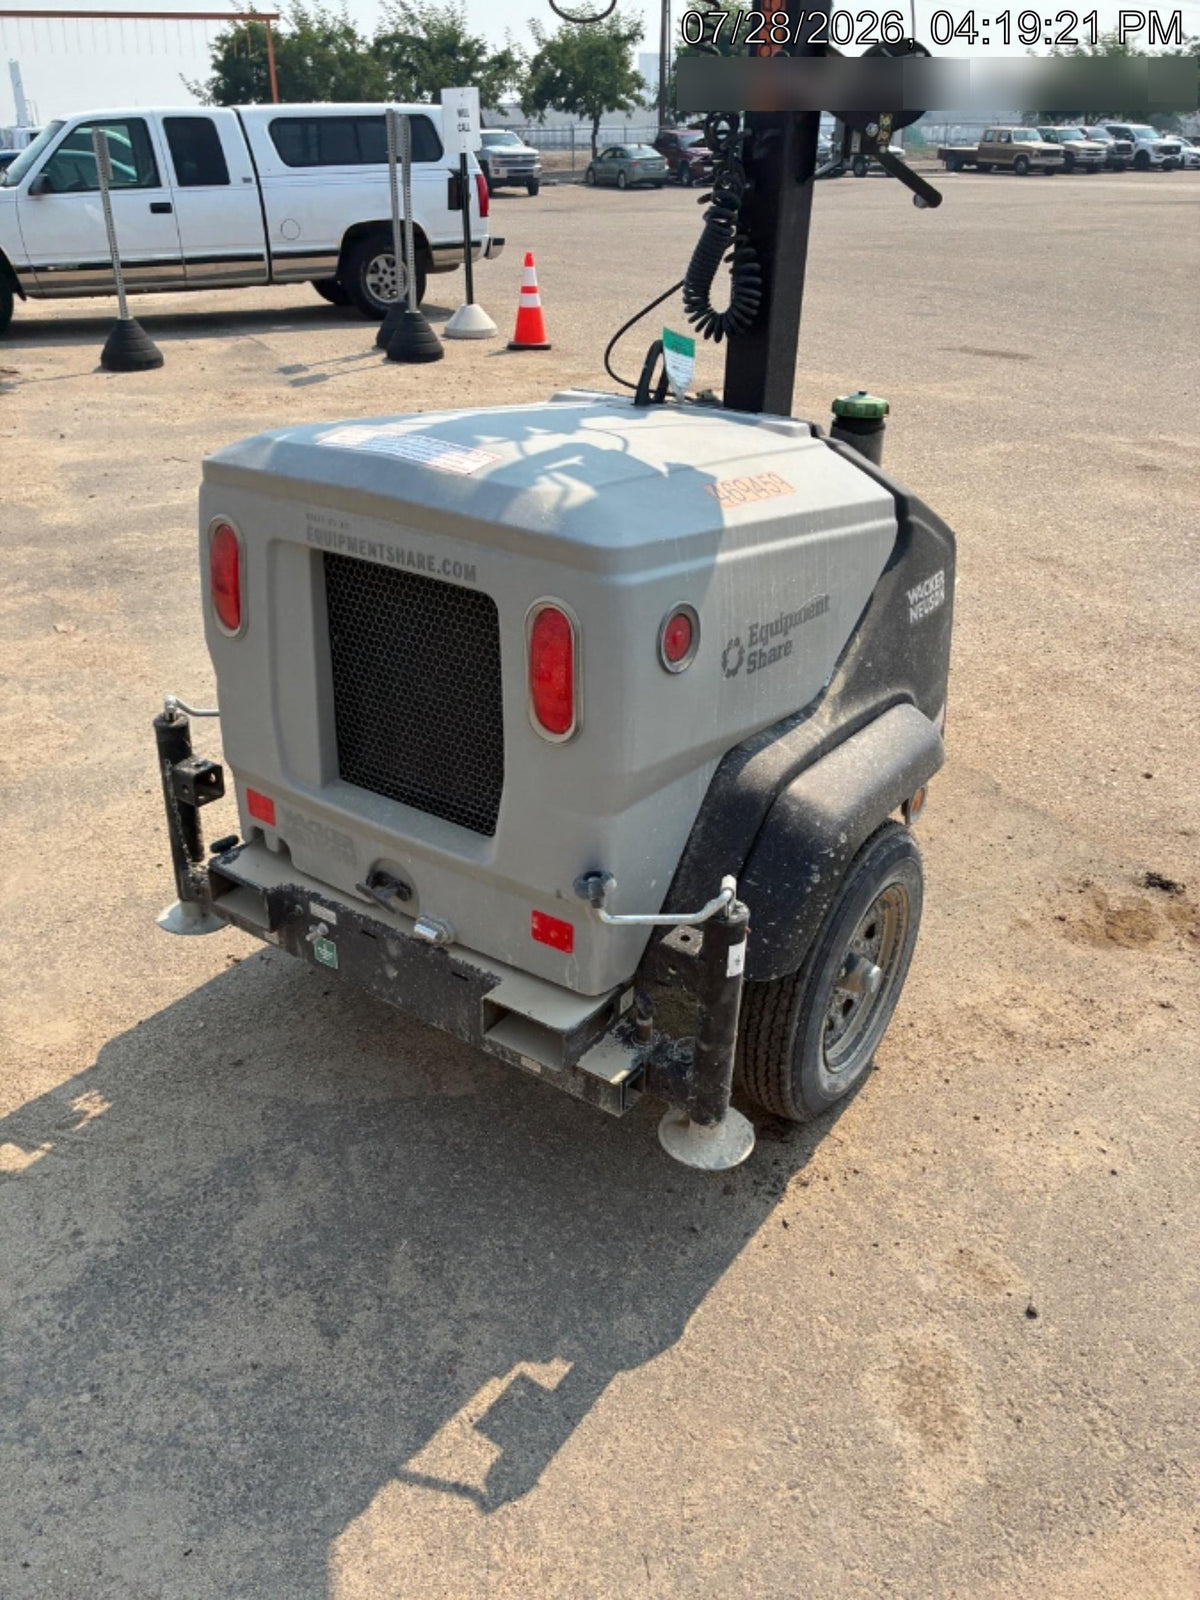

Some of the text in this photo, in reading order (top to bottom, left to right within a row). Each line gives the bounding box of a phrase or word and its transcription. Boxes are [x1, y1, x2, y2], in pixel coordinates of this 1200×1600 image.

[457, 122, 471, 132] CALL
[306, 525, 477, 582] EQUIPMENTSHARE.COM
[905, 570, 945, 605] WACKER
[748, 594, 830, 648] Equipment
[910, 588, 945, 623] NEUSON
[746, 639, 793, 674] Share
